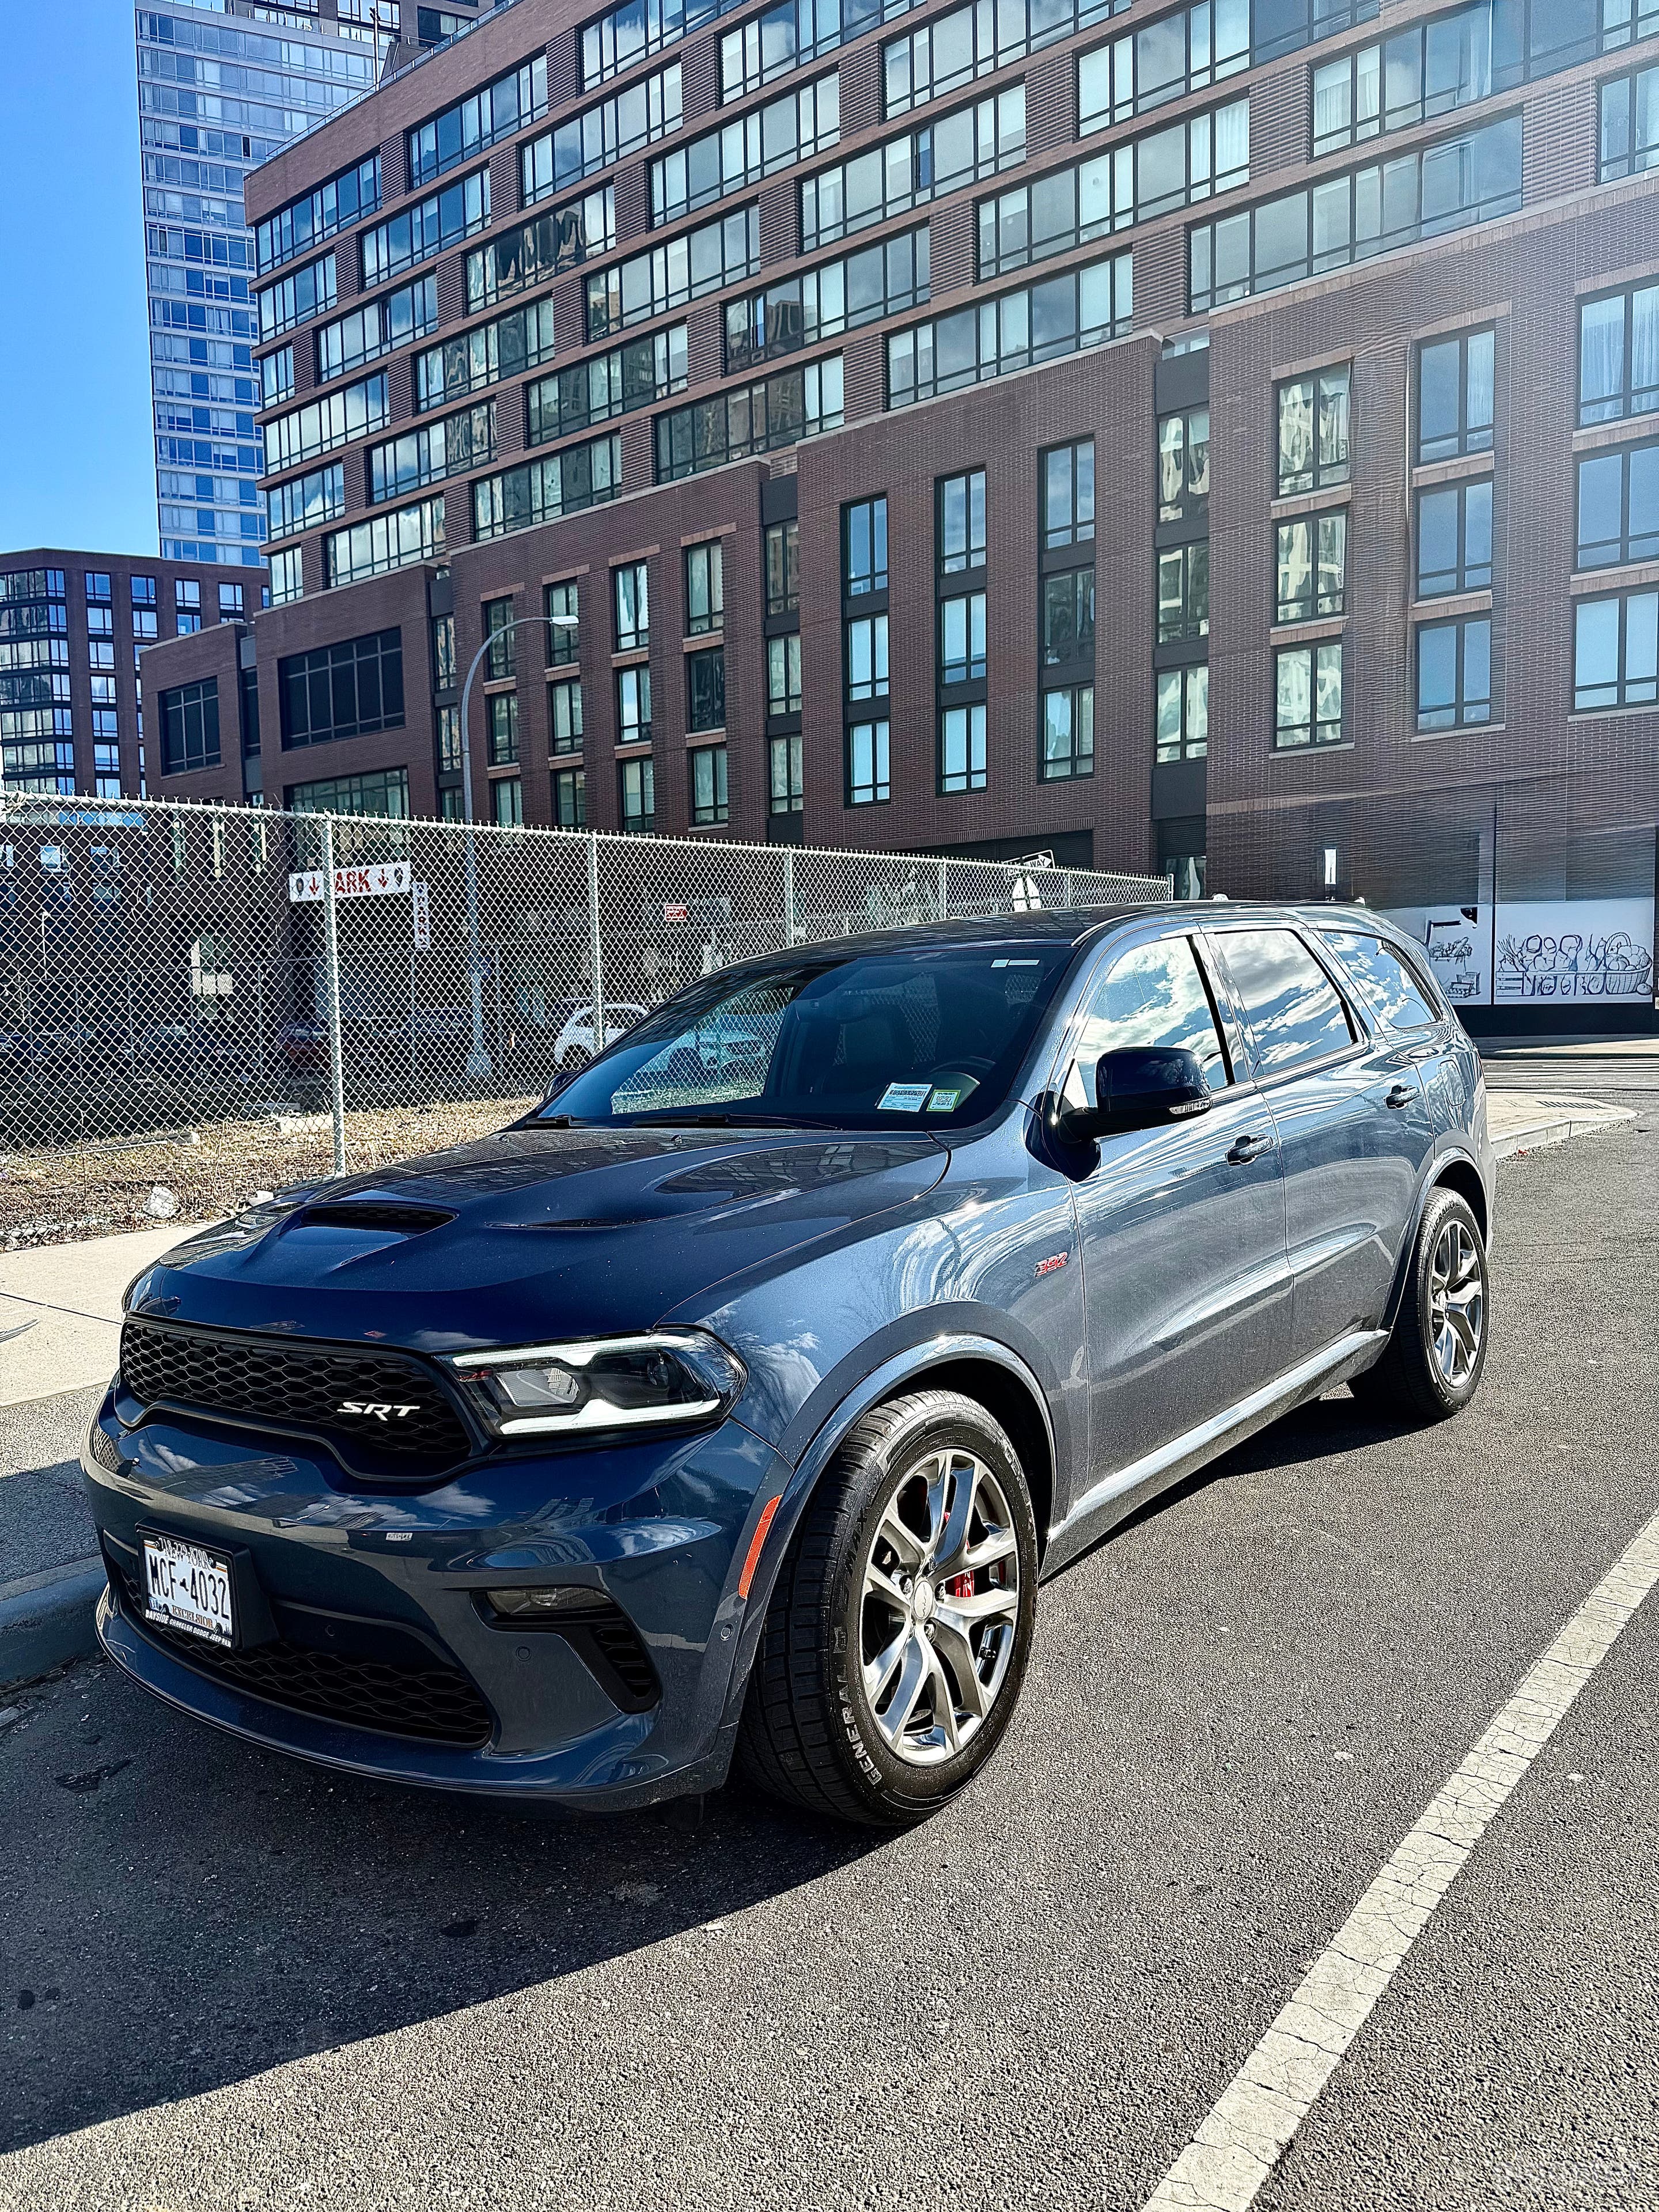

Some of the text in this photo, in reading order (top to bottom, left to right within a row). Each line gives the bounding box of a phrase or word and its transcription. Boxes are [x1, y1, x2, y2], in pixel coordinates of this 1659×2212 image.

[335, 869, 372, 893] ARK
[336, 1402, 421, 1421] SRT
[149, 1554, 230, 1619] MCF 4032
[145, 1609, 169, 1624] BAYSIDE
[169, 1618, 193, 1633] CHRYSLER
[193, 1627, 210, 1638] DODGE
[209, 1633, 222, 1643] JEEP
[837, 1664, 882, 1785] GENERAL
